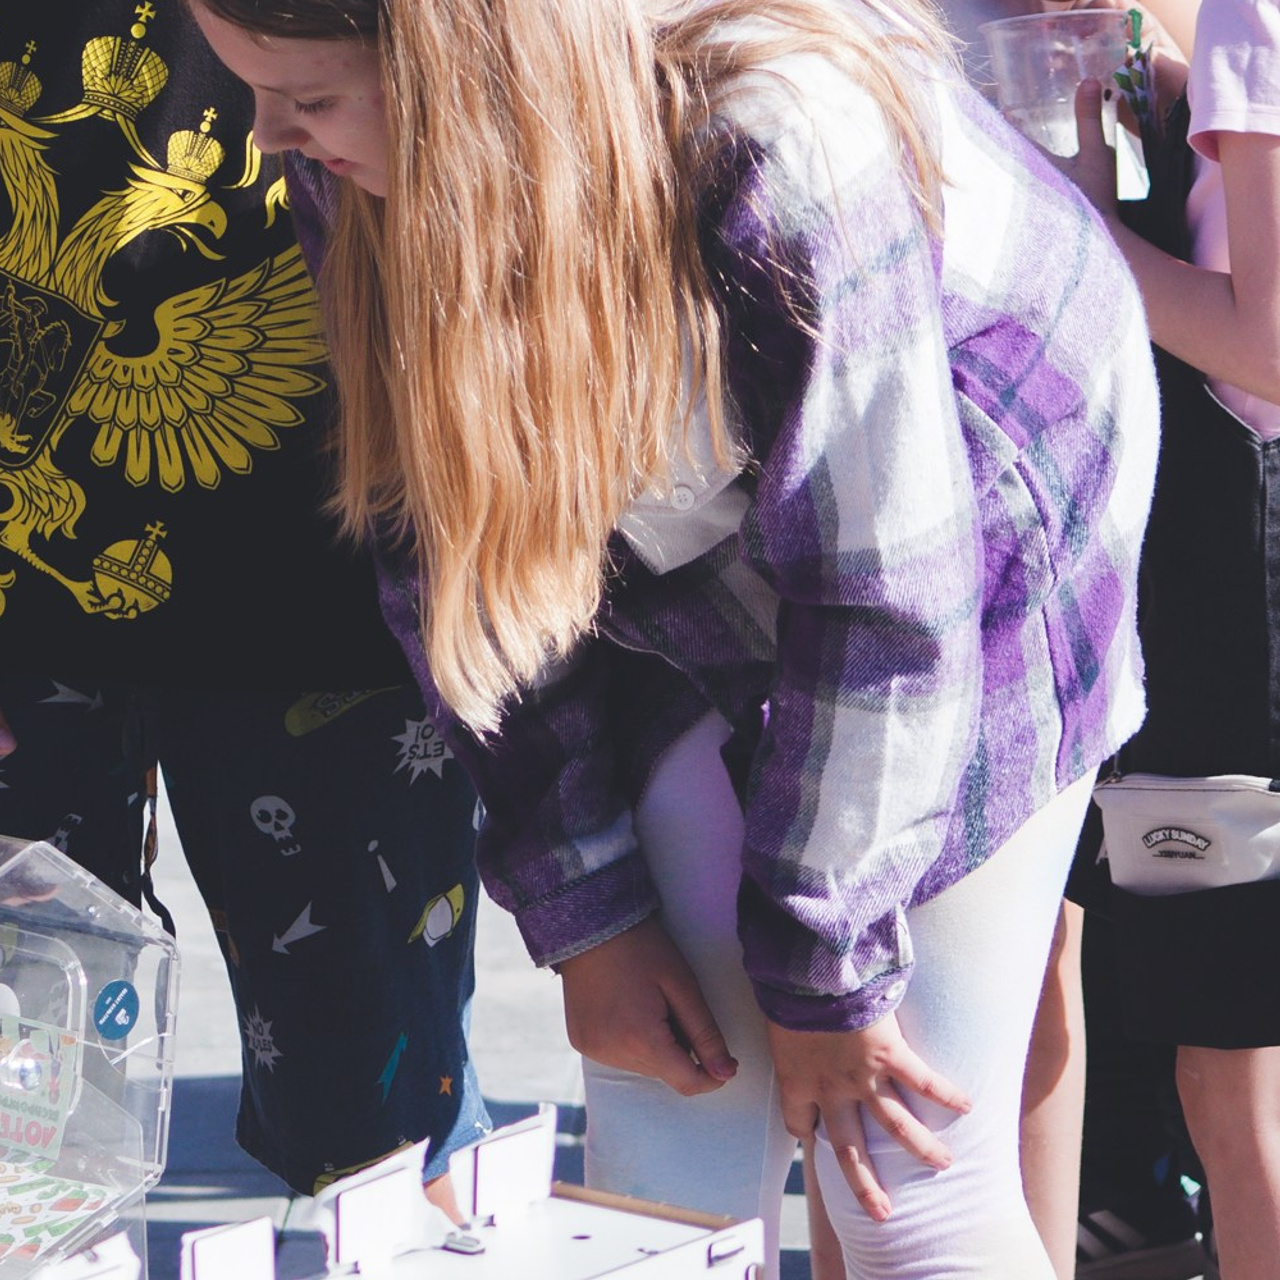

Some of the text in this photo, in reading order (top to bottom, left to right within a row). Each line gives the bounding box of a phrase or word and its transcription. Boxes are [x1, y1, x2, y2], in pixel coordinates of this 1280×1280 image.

[415, 725, 436, 743] O!
[408, 740, 446, 760] ET'S
[1144, 829, 1209, 850] LUCKY SUNDAY
